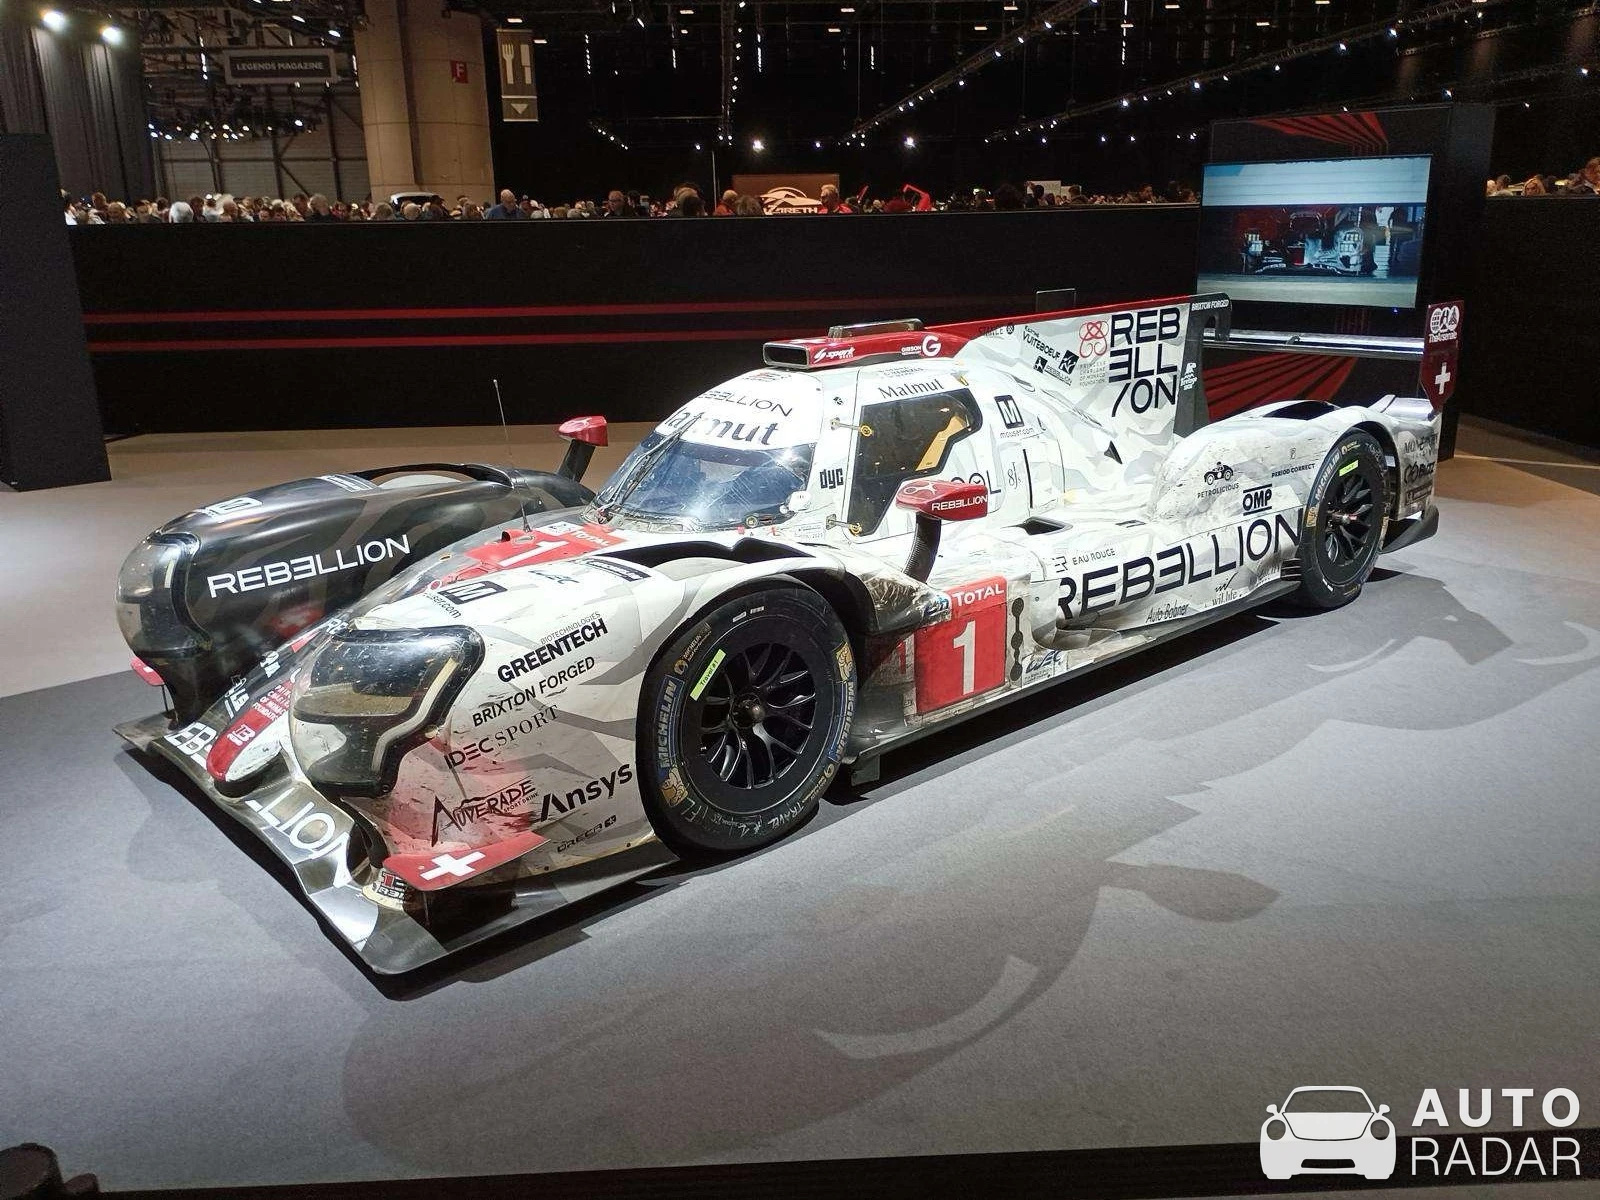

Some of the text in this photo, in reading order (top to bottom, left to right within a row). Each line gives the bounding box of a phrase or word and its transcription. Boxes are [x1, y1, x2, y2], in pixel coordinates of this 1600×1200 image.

[236, 62, 323, 71] LEGENDS MAGAZINE
[931, 494, 989, 512] REBELLION
[1197, 482, 1240, 499] PETROLICIOUS
[1242, 487, 1273, 512] OMP
[207, 534, 411, 599] REBELLION
[1057, 507, 1304, 620] REBELLION
[952, 583, 1005, 607] TOTAL
[497, 617, 609, 683] GREENTECH
[540, 611, 601, 645] BIOTECHNOLOGIES
[952, 619, 976, 696] 1
[473, 656, 595, 727] BRIXTON FORGED
[496, 704, 560, 748] SPORT
[657, 679, 679, 769] MICHELIN
[502, 792, 540, 813] SPORT DRINK
[540, 763, 634, 823] Ansys
